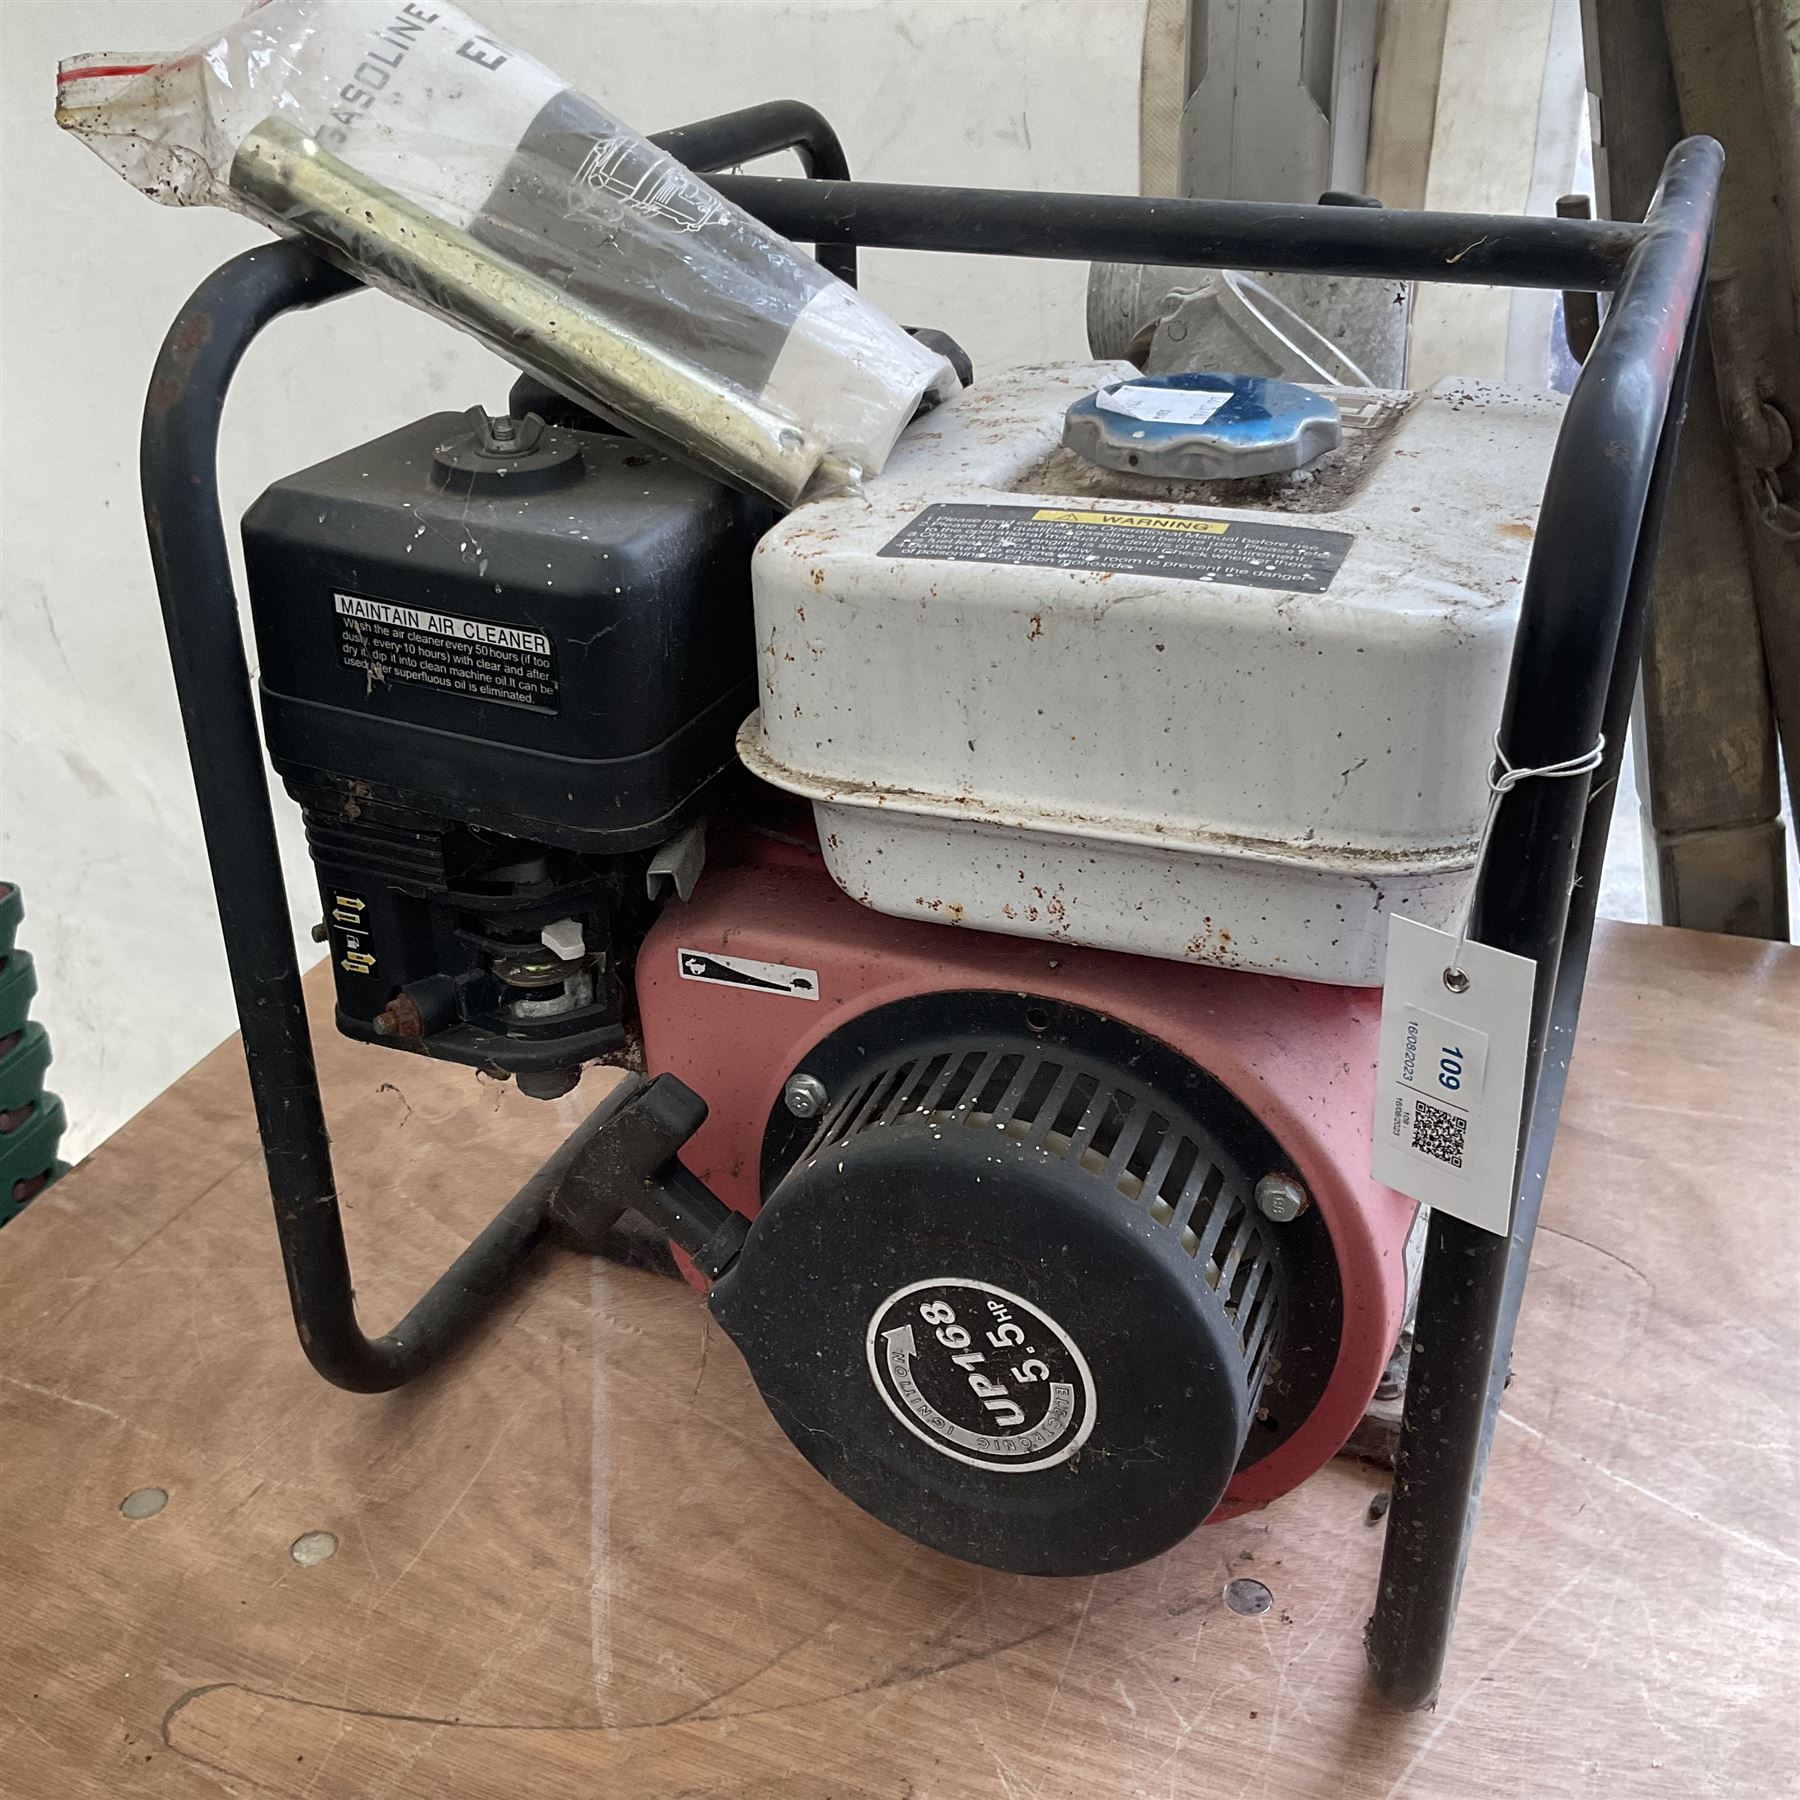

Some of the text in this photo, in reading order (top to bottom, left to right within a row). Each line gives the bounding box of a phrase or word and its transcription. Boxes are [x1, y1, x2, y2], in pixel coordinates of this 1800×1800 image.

[931, 521, 977, 529] Please
[1075, 531, 1134, 541] gasoline
[1158, 535, 1205, 545] before
[1244, 543, 1295, 554] Please
[953, 532, 994, 540] refuel
[1030, 538, 1079, 547] engine
[965, 529, 1044, 539] operational
[1045, 534, 1098, 542] manual
[1124, 539, 1171, 548] details
[1016, 519, 1072, 530] carefully
[1076, 523, 1098, 531] the
[1101, 525, 1184, 537] Operational
[1184, 532, 1239, 542] Manual
[1241, 537, 1289, 548] before
[1102, 515, 1209, 531] WARNING
[955, 539, 1007, 549] leakag
[1004, 554, 1054, 563] carbon
[1005, 549, 1054, 558] engine
[1057, 552, 1100, 561] isid
[1104, 556, 1141, 564] room
[1162, 561, 1221, 571] prevent
[1225, 566, 1249, 574] the
[341, 597, 546, 653] MAINTAIN AIR CLEANER
[343, 617, 550, 668] Wsh the air cleaner every 50 hours (if too
[342, 643, 357, 657] dry
[372, 650, 388, 663] dip
[390, 652, 397, 663] it
[399, 656, 418, 668] into
[420, 660, 447, 674] clean
[450, 667, 492, 681] machine
[518, 681, 538, 692] can
[540, 683, 554, 695] be
[344, 656, 369, 670] used
[394, 667, 451, 687] superfluous
[454, 680, 466, 690] oil
[469, 682, 477, 692] is
[373, 638, 400, 653] every
[404, 642, 416, 655] 10
[418, 645, 450, 664] hours)
[452, 654, 474, 667] with
[476, 658, 501, 672] clear
[504, 664, 524, 676] and
[526, 668, 550, 681] after
[1403, 1021, 1418, 1082] 16/08/2023
[1439, 1047, 1464, 1090] 109
[919, 1300, 1025, 1427] UP168
[891, 1351, 1070, 1451] ELECTRONIC IGNITION
